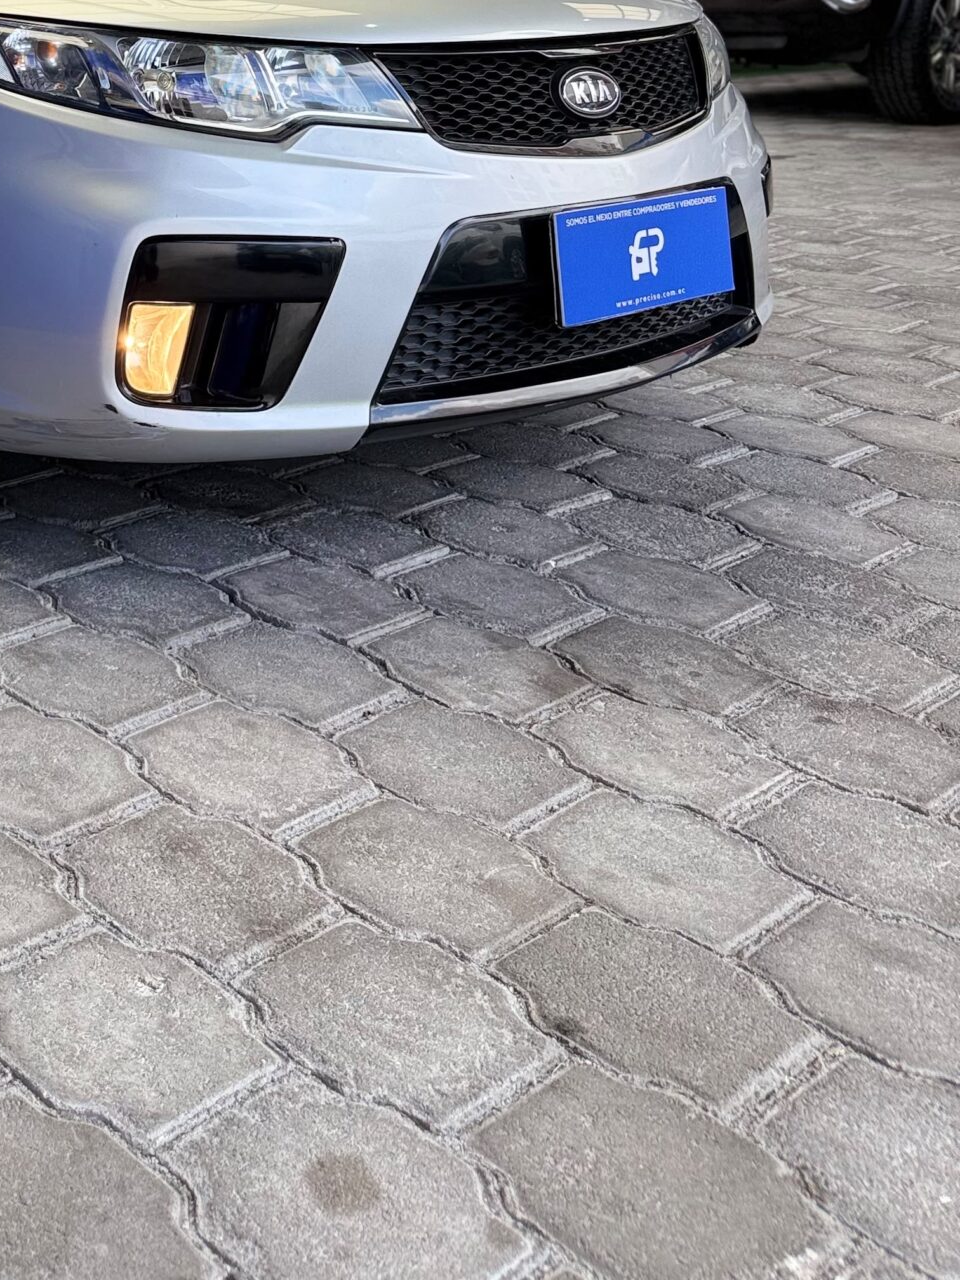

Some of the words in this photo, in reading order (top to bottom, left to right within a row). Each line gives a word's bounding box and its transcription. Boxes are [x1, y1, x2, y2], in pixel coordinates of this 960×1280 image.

[570, 75, 613, 104] KIA
[565, 215, 588, 227] SOMOS
[588, 213, 595, 223] EL
[596, 211, 613, 222] NEXO
[613, 208, 632, 219] ENTRE
[632, 202, 676, 216] COMPRADORES
[680, 195, 717, 208] VENDEDORES
